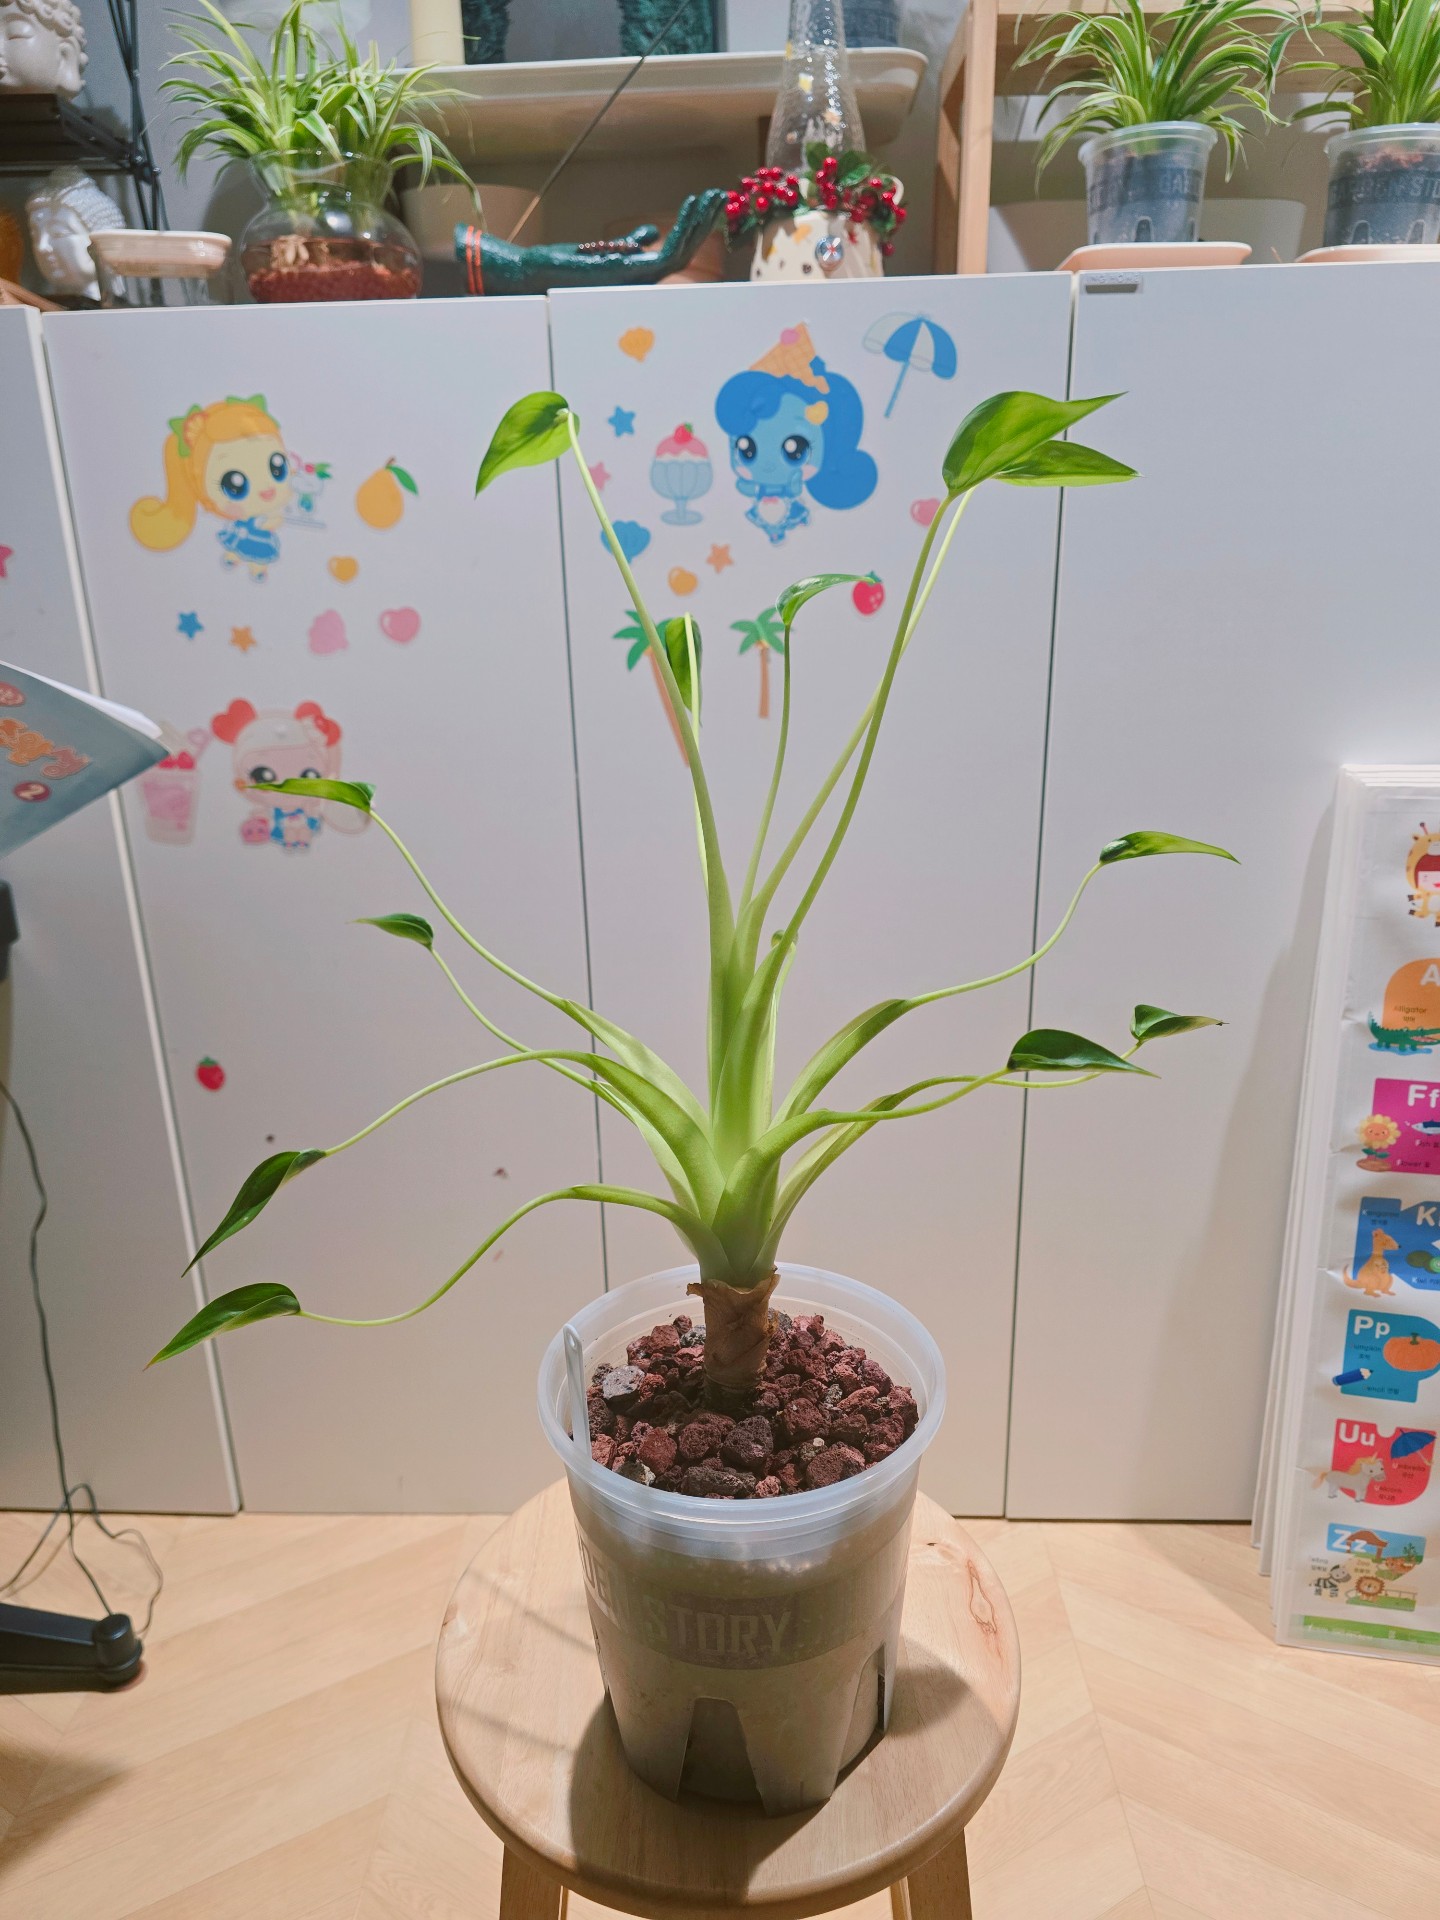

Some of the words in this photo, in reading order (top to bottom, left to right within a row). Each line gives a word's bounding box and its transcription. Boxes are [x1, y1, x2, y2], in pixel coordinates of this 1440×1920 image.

[1408, 1084, 1440, 1108] Ff
[1416, 1205, 1440, 1228] K
[1353, 1315, 1391, 1339] Pp
[1339, 1422, 1376, 1447] Uu
[1332, 1528, 1367, 1553] Zz
[642, 1594, 792, 1658] STORY
